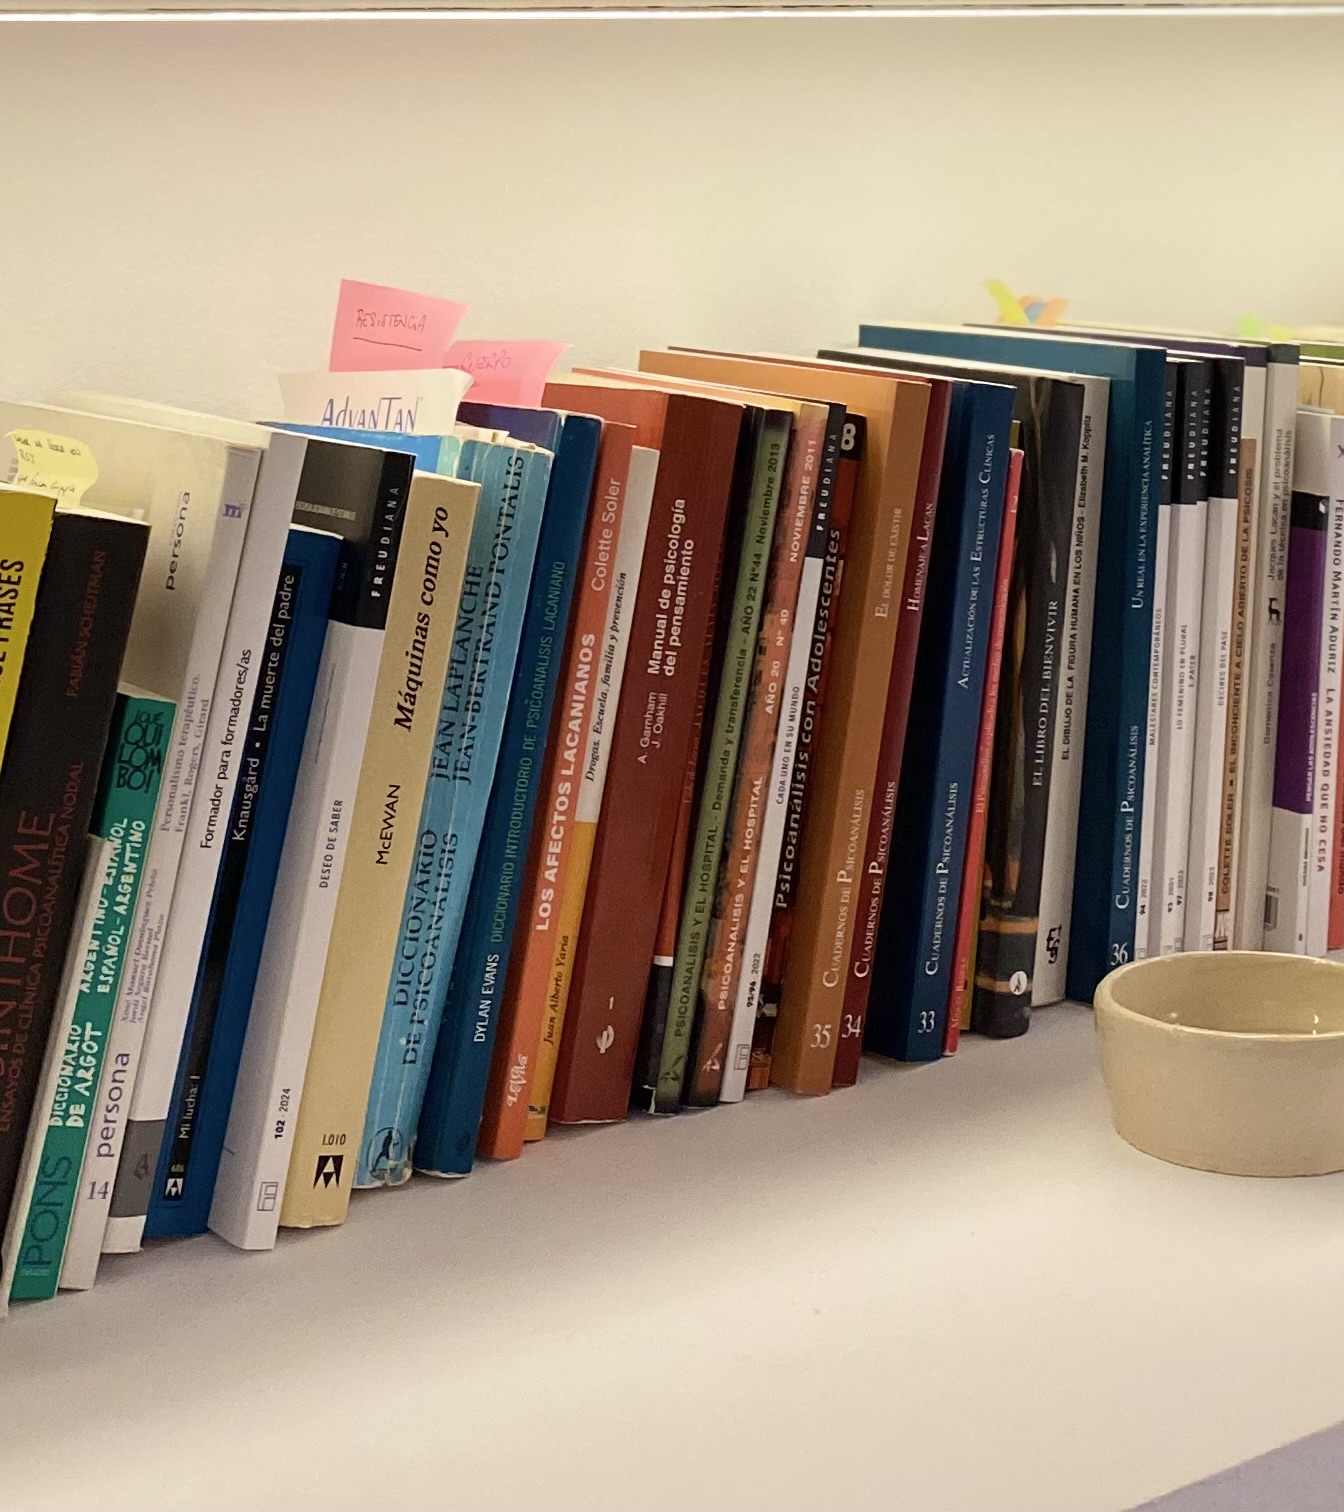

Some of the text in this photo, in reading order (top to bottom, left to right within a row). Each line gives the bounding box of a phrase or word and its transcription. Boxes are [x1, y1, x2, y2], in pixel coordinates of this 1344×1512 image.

[591, 477, 620, 591] Colette Soler
[269, 623, 285, 646] del
[277, 575, 294, 619] padre
[393, 506, 448, 732] Máquinas como yo
[647, 499, 685, 674] Manual de psicología
[662, 539, 694, 676] del pensamiento
[252, 714, 268, 731] La
[260, 652, 279, 708] muerte
[375, 784, 400, 864] McEWAN
[535, 633, 595, 930] LOS AFECTOS LACANIANOS
[96, 1053, 130, 1157] persona
